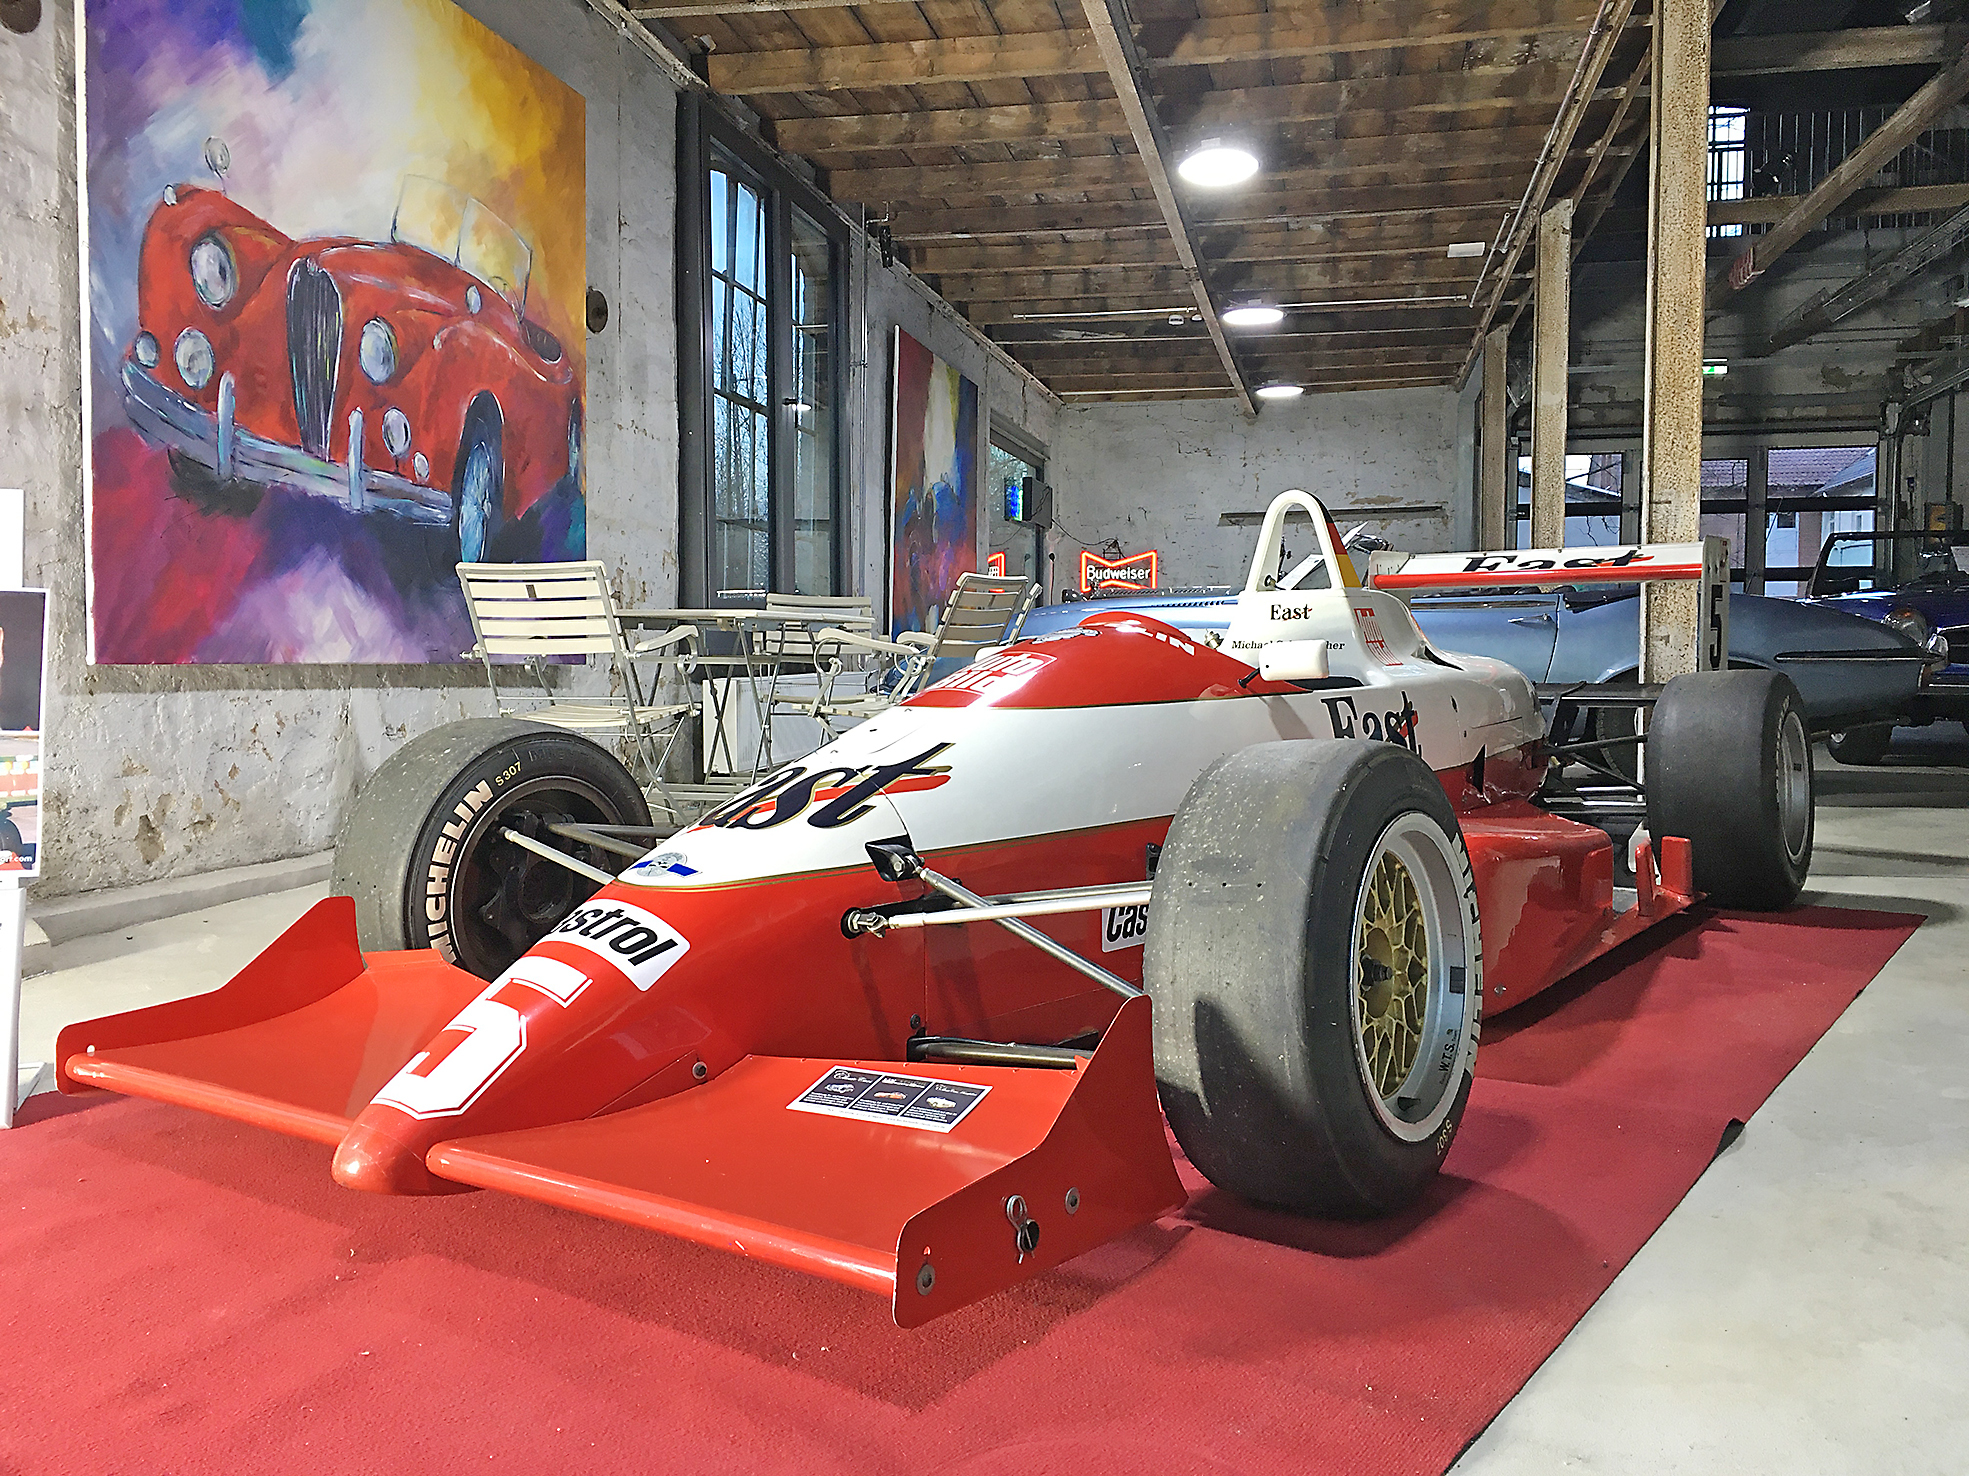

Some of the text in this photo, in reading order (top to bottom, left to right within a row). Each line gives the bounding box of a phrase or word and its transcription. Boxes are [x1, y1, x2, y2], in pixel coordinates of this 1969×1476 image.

[1086, 565, 1151, 579] Budweiser
[1270, 603, 1312, 621] East
[1709, 584, 1723, 671] 5
[1231, 640, 1273, 650] Micha
[495, 761, 523, 786] S307
[698, 742, 956, 829] ast
[370, 955, 594, 1120] 5
